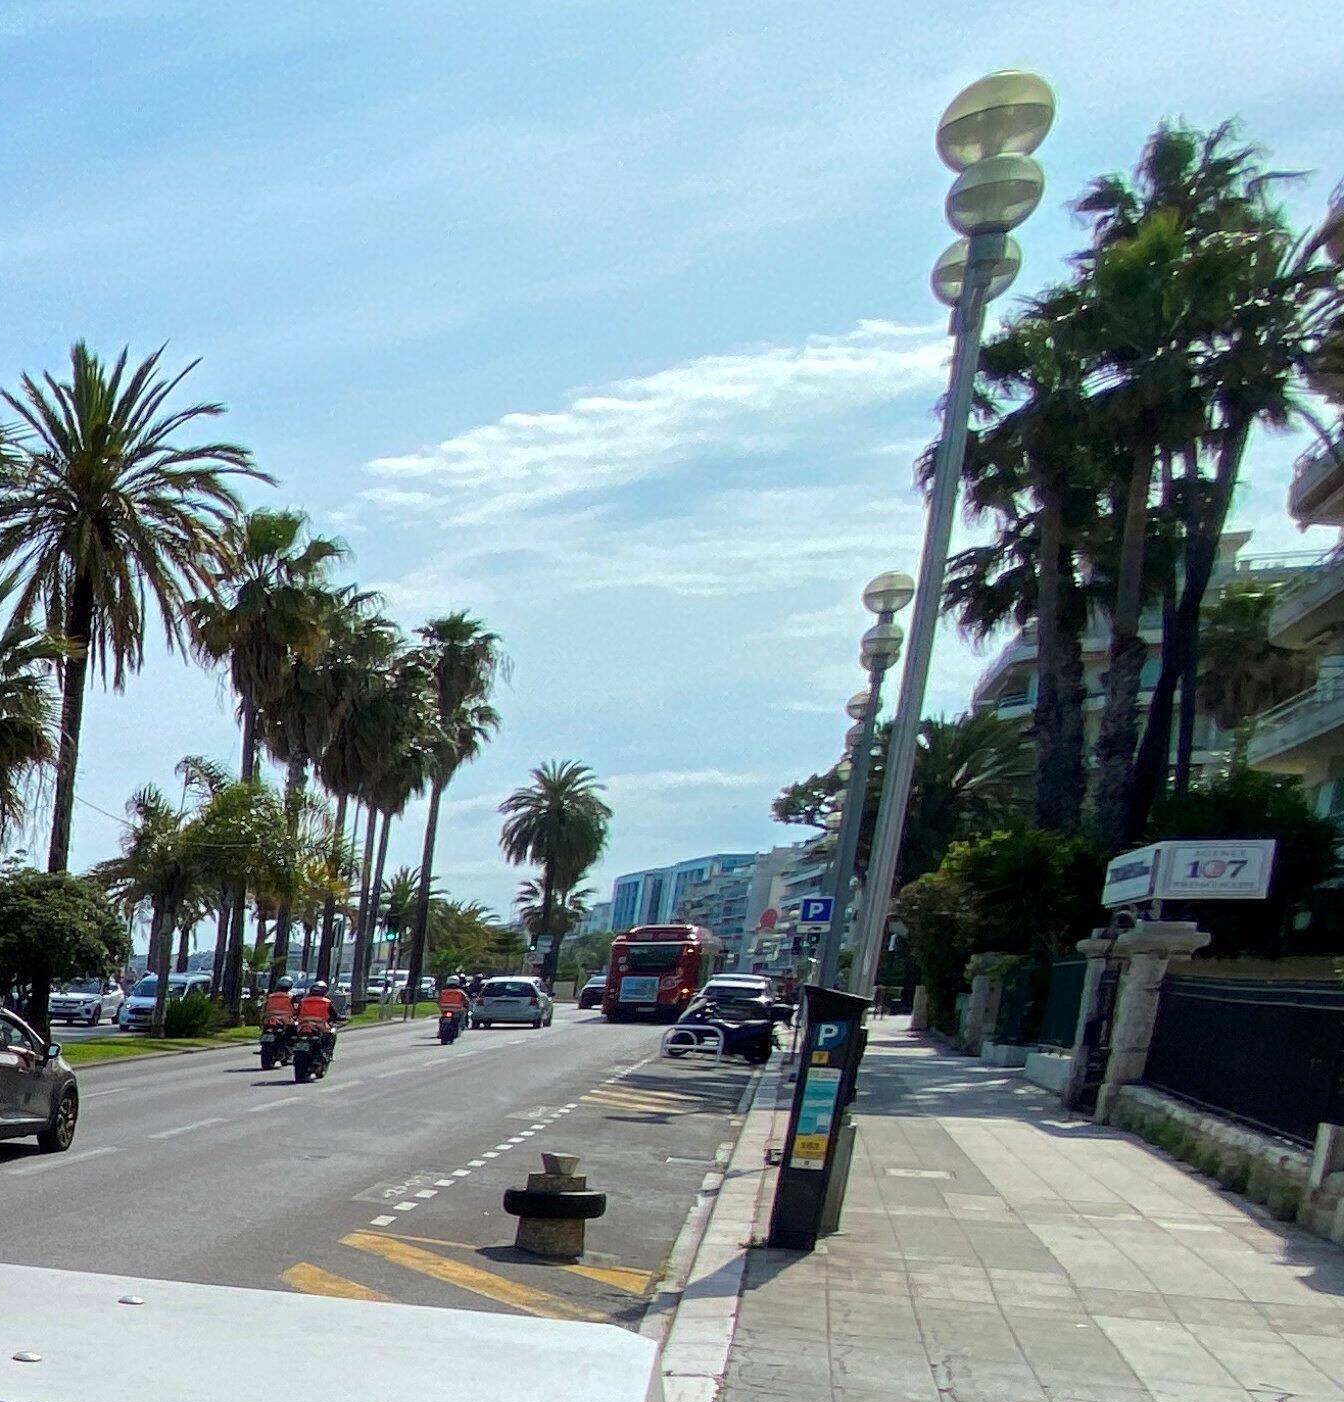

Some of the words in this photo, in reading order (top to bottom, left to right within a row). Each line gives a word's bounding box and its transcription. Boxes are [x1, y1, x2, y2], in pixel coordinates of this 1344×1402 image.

[1185, 859, 1249, 880] 107
[808, 902, 824, 919] P
[818, 1023, 839, 1047] P
